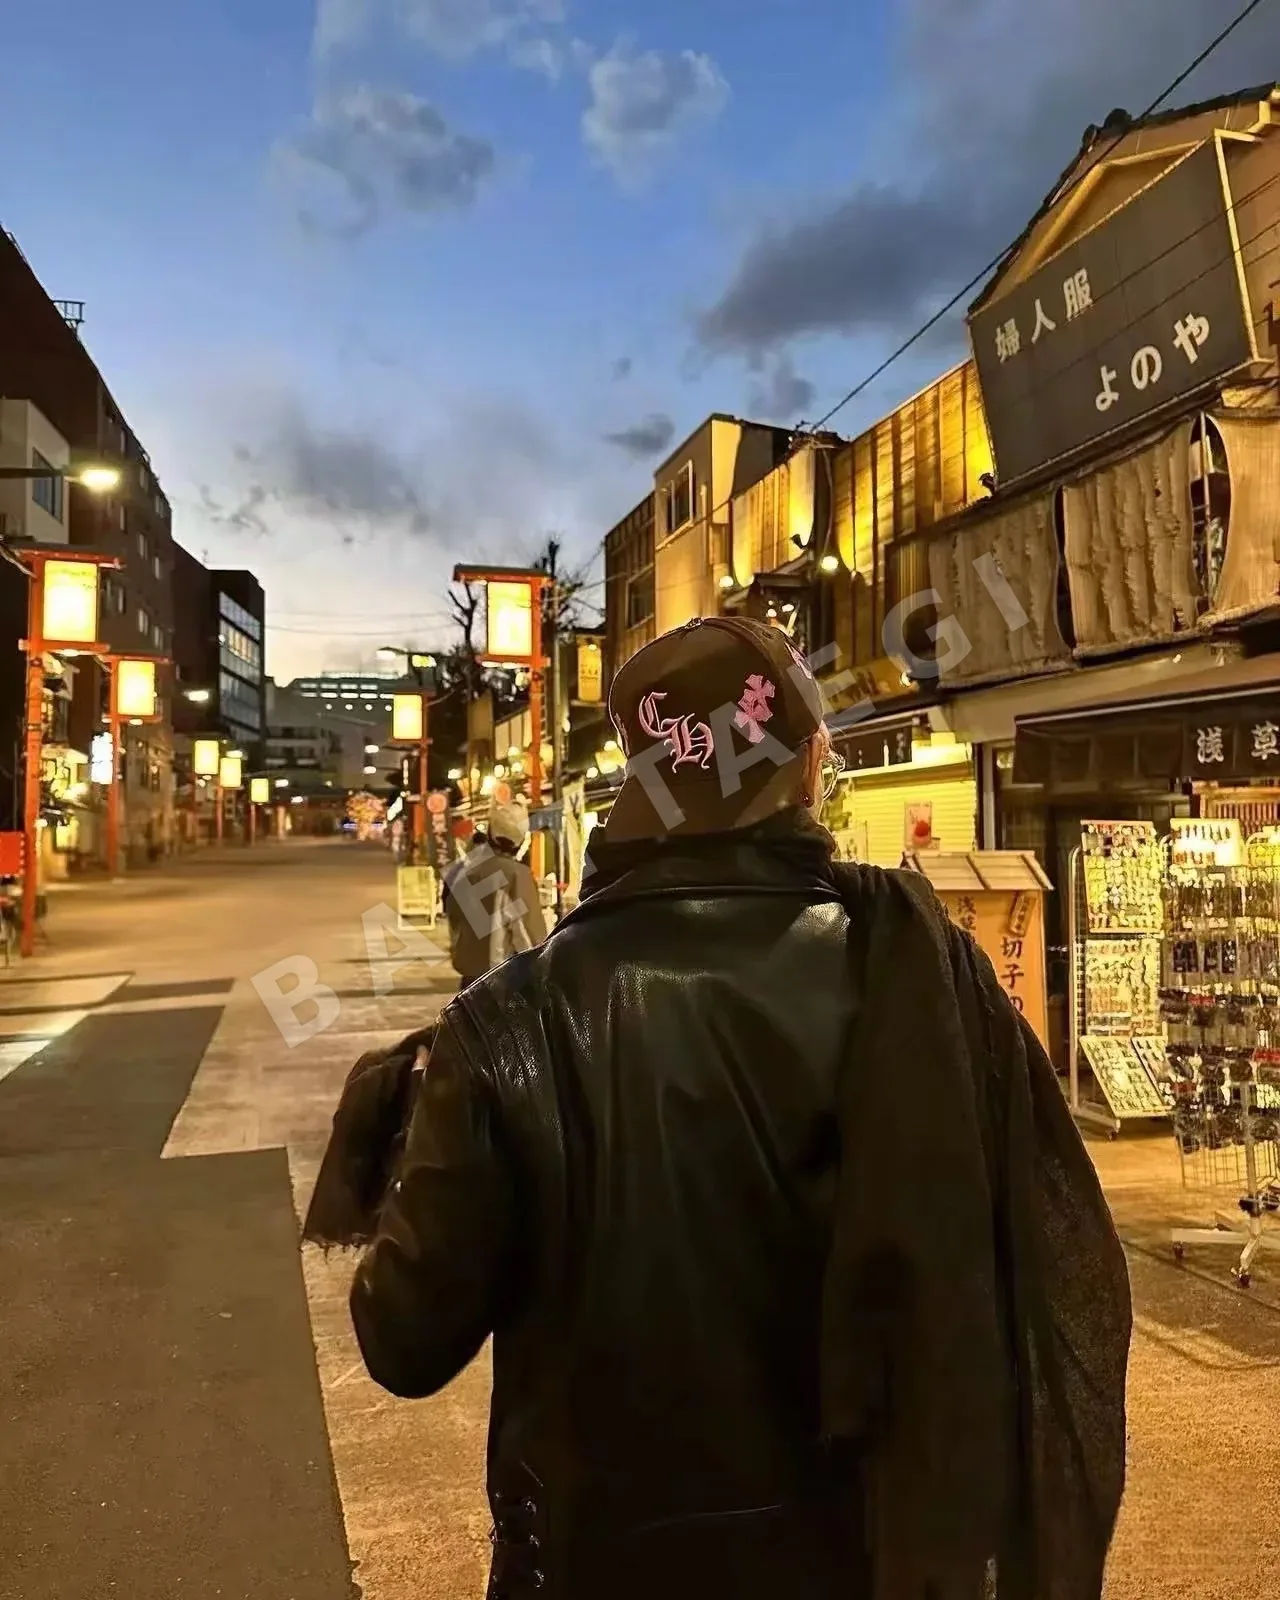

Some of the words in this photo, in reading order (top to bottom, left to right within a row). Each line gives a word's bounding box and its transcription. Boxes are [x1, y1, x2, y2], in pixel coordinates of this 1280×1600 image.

[995, 267, 1094, 364] 婦人服
[1095, 312, 1210, 412] よのや
[1197, 720, 1280, 764] 浅草
